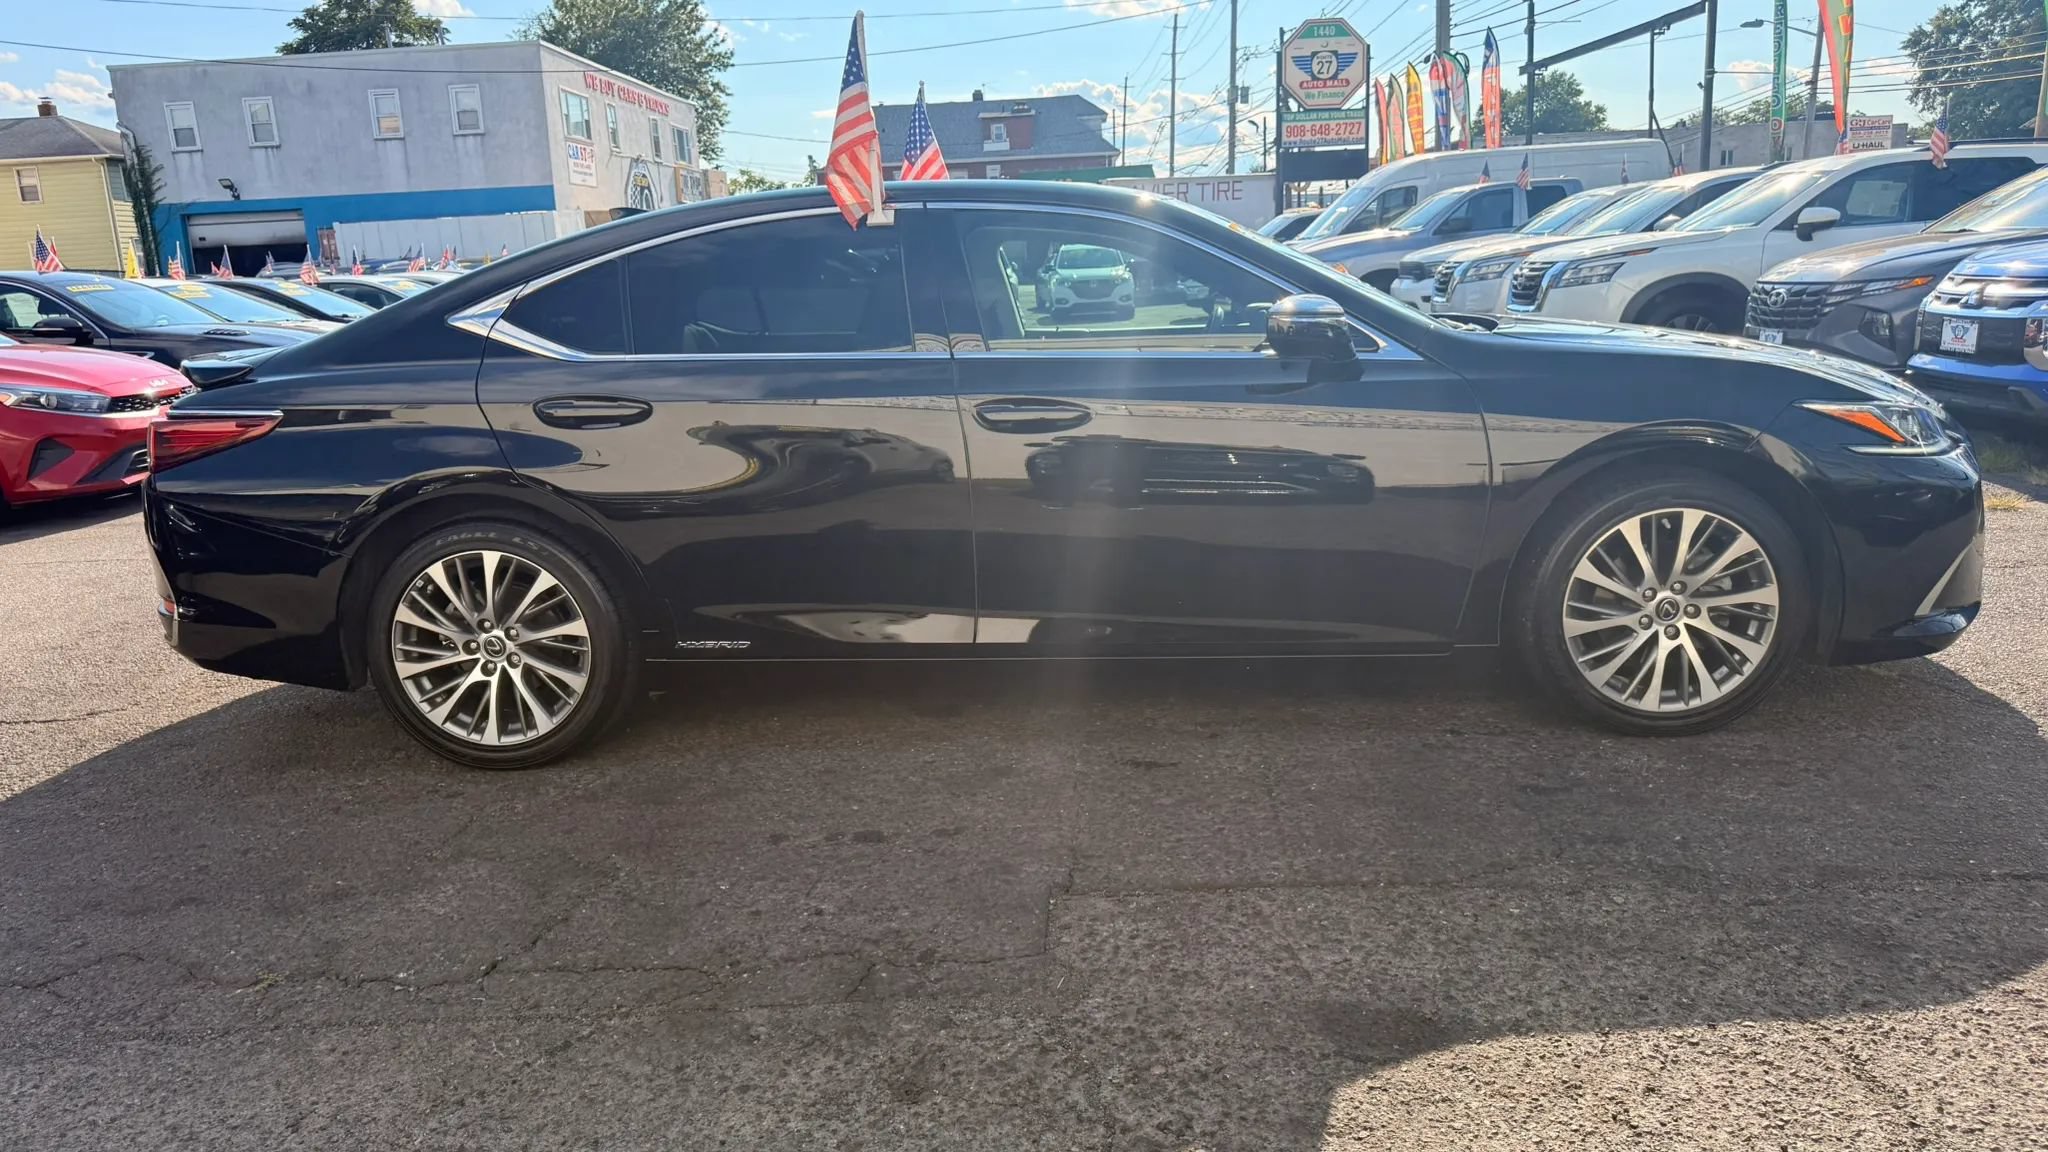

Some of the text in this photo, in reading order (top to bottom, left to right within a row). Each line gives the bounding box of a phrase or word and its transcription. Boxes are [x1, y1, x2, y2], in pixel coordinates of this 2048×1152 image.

[1313, 26, 1336, 37] 1440
[1316, 61, 1333, 75] 27
[584, 72, 598, 91] WE
[600, 78, 616, 97] BUY
[618, 85, 637, 105] CARS
[644, 94, 670, 117] TRUCKS
[1304, 90, 1346, 99] We Finance
[1285, 122, 1362, 138] 908-648-2727
[568, 143, 580, 160] CAR
[1852, 141, 1885, 149] U-HAUL
[1196, 181, 1243, 202] TIRE
[674, 640, 752, 649] HYBRID
